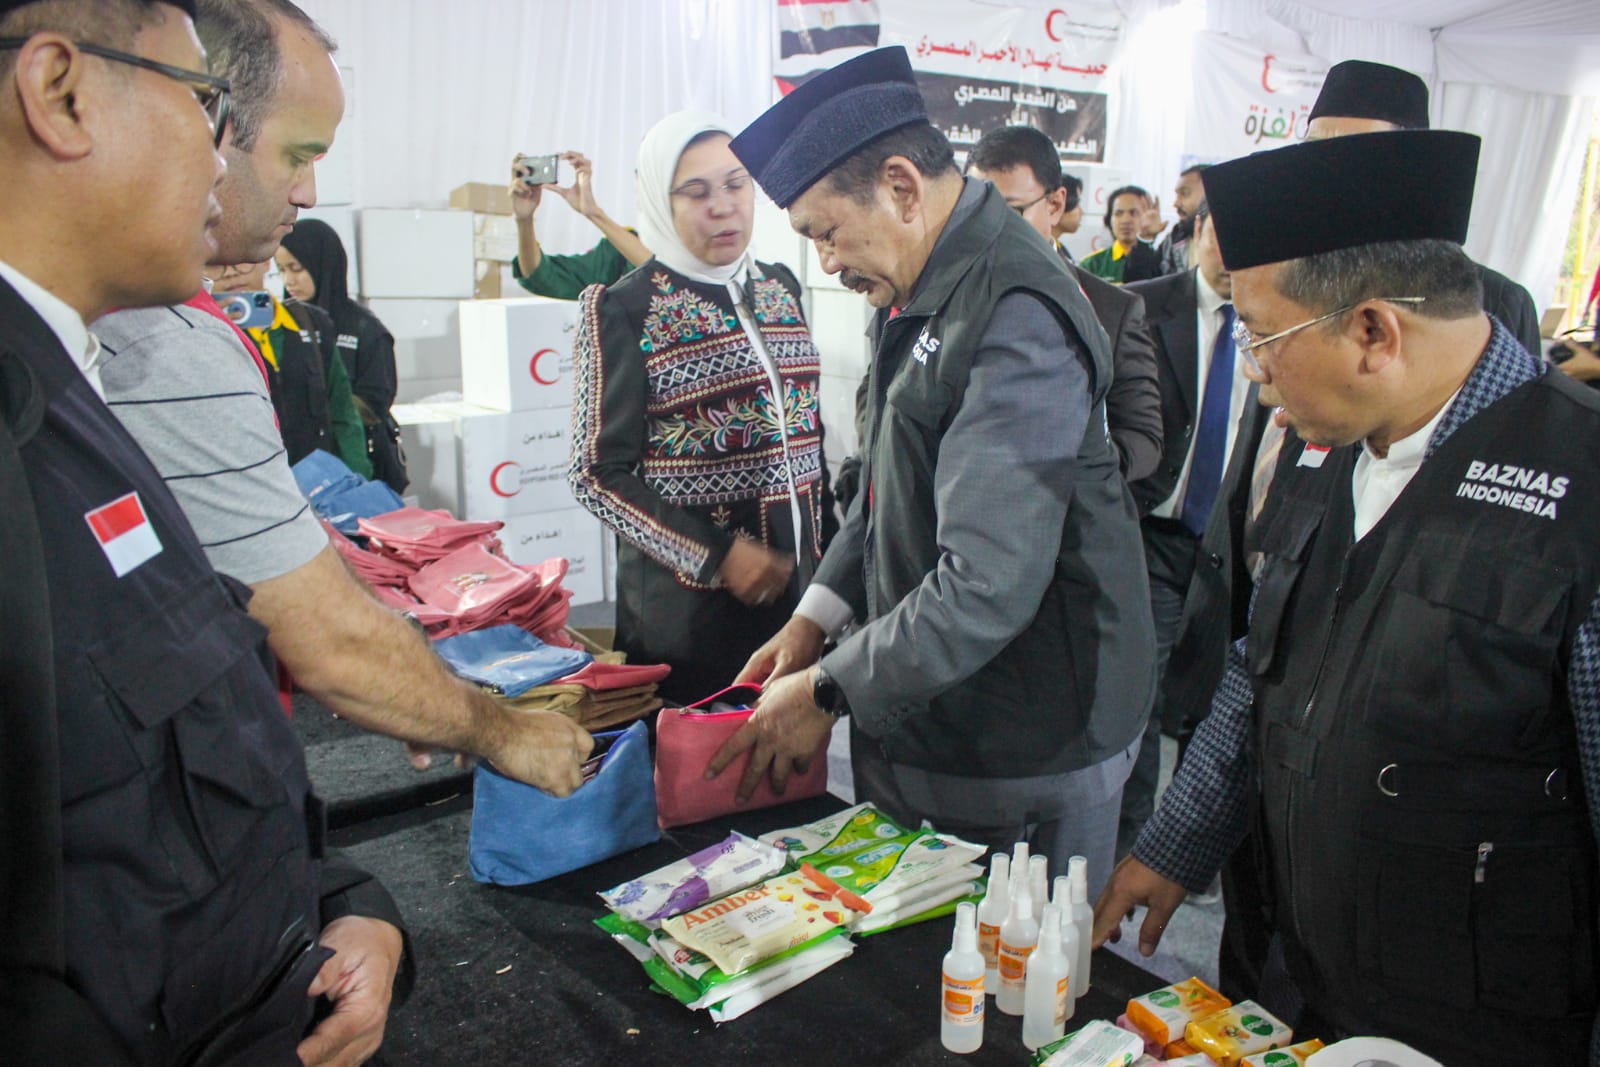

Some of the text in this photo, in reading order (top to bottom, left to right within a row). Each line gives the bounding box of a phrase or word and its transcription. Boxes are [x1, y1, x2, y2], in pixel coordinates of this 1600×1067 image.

[954, 85, 1077, 113] من الشعب المصري
[1465, 460, 1570, 498] BAZNAS
[1456, 482, 1557, 520] INDONESIA
[682, 885, 772, 931] Amber
